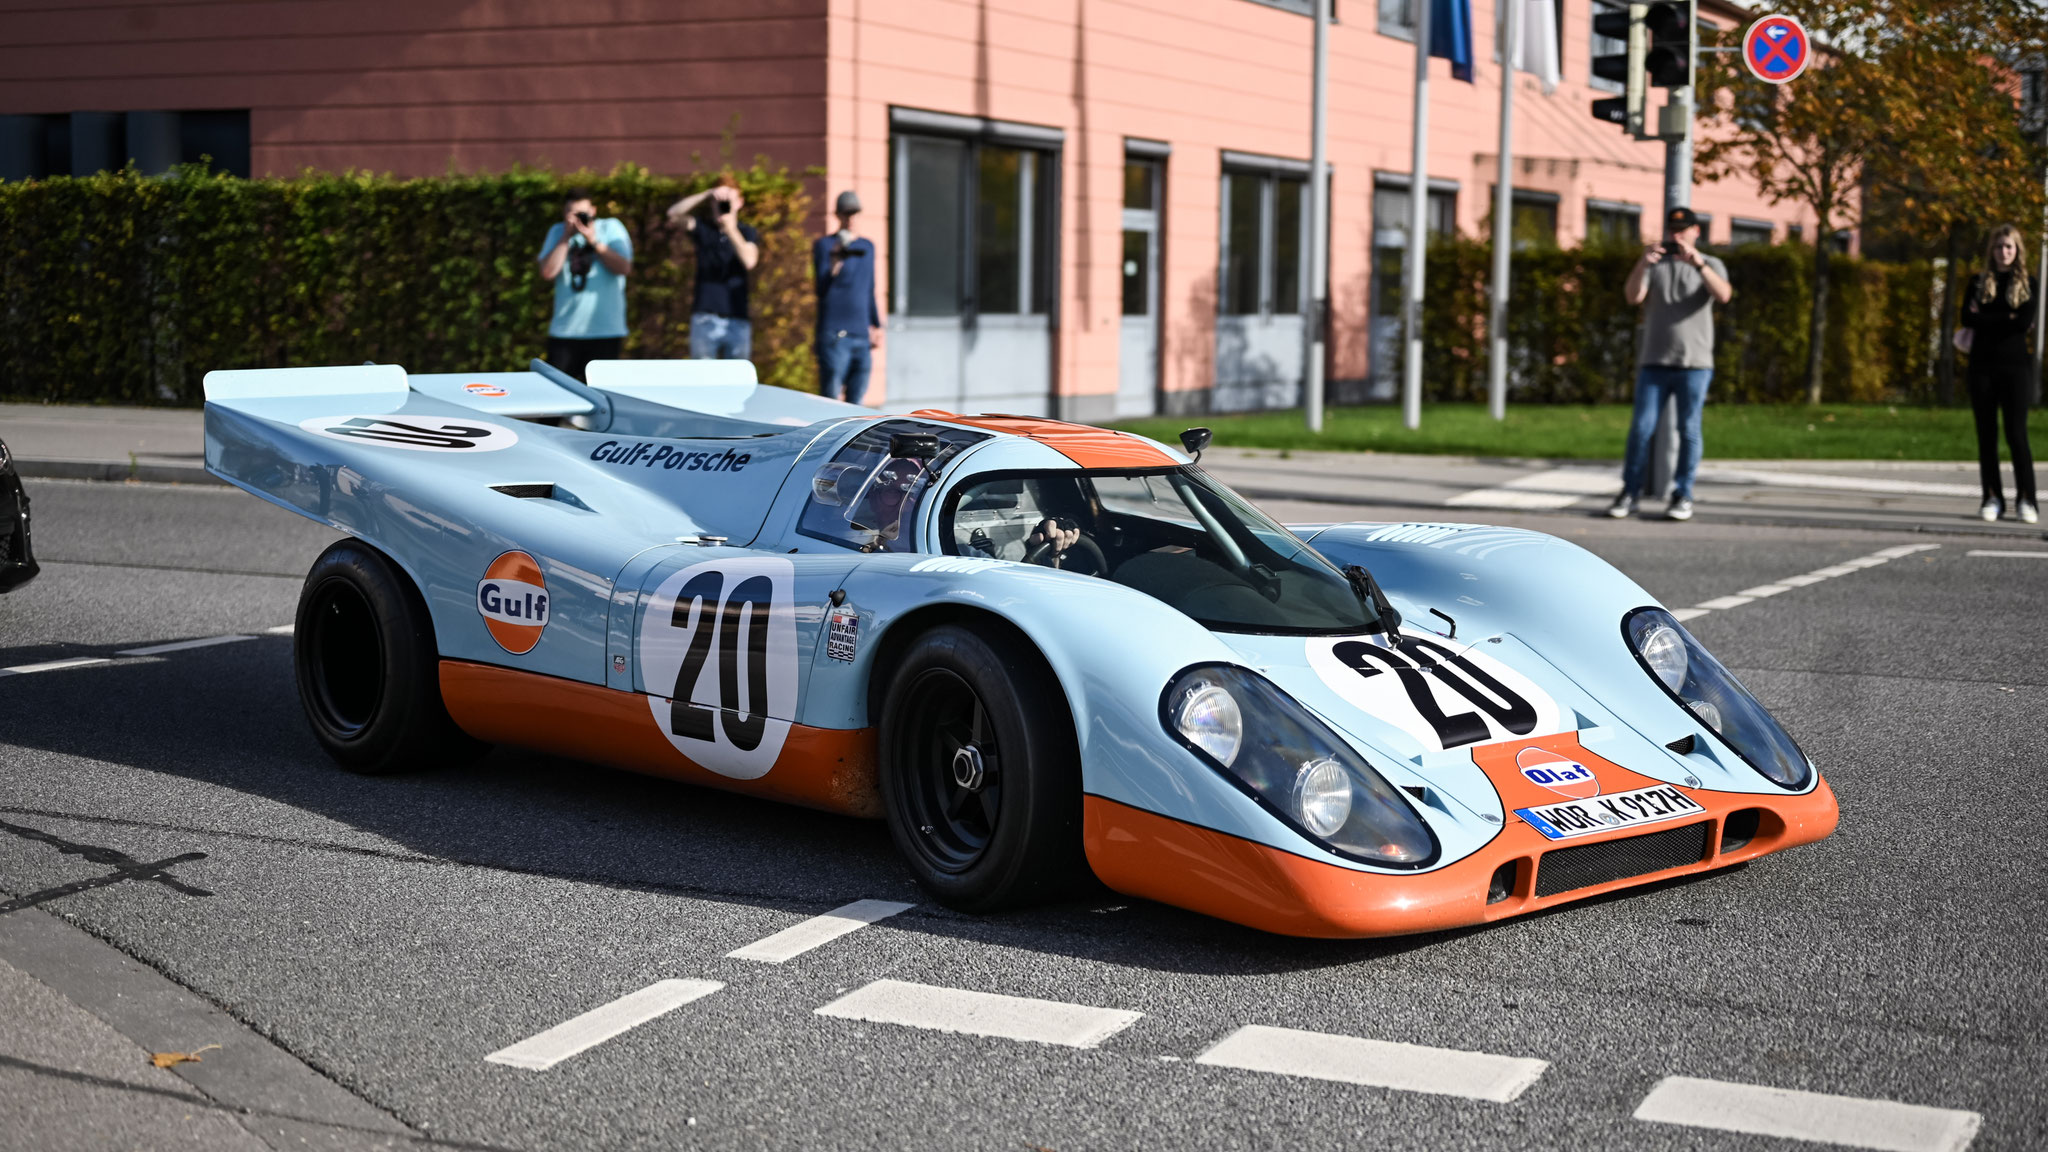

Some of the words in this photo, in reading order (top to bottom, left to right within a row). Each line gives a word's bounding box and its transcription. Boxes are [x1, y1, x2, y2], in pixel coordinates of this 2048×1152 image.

[324, 417, 492, 449] 20
[590, 441, 752, 472] Gulf-Porsche
[480, 583, 547, 621] Gulf
[830, 632, 855, 645] ADVANTAGE
[831, 623, 856, 635] UNFAIR
[671, 570, 773, 752] 20
[829, 641, 854, 652] RACING
[1332, 634, 1538, 750] 20
[1524, 764, 1591, 784] Olaf
[1535, 804, 1604, 832] WOR
[1597, 798, 1636, 822] K
[1619, 786, 1697, 818] 917H
[1541, 825, 1554, 834] D
